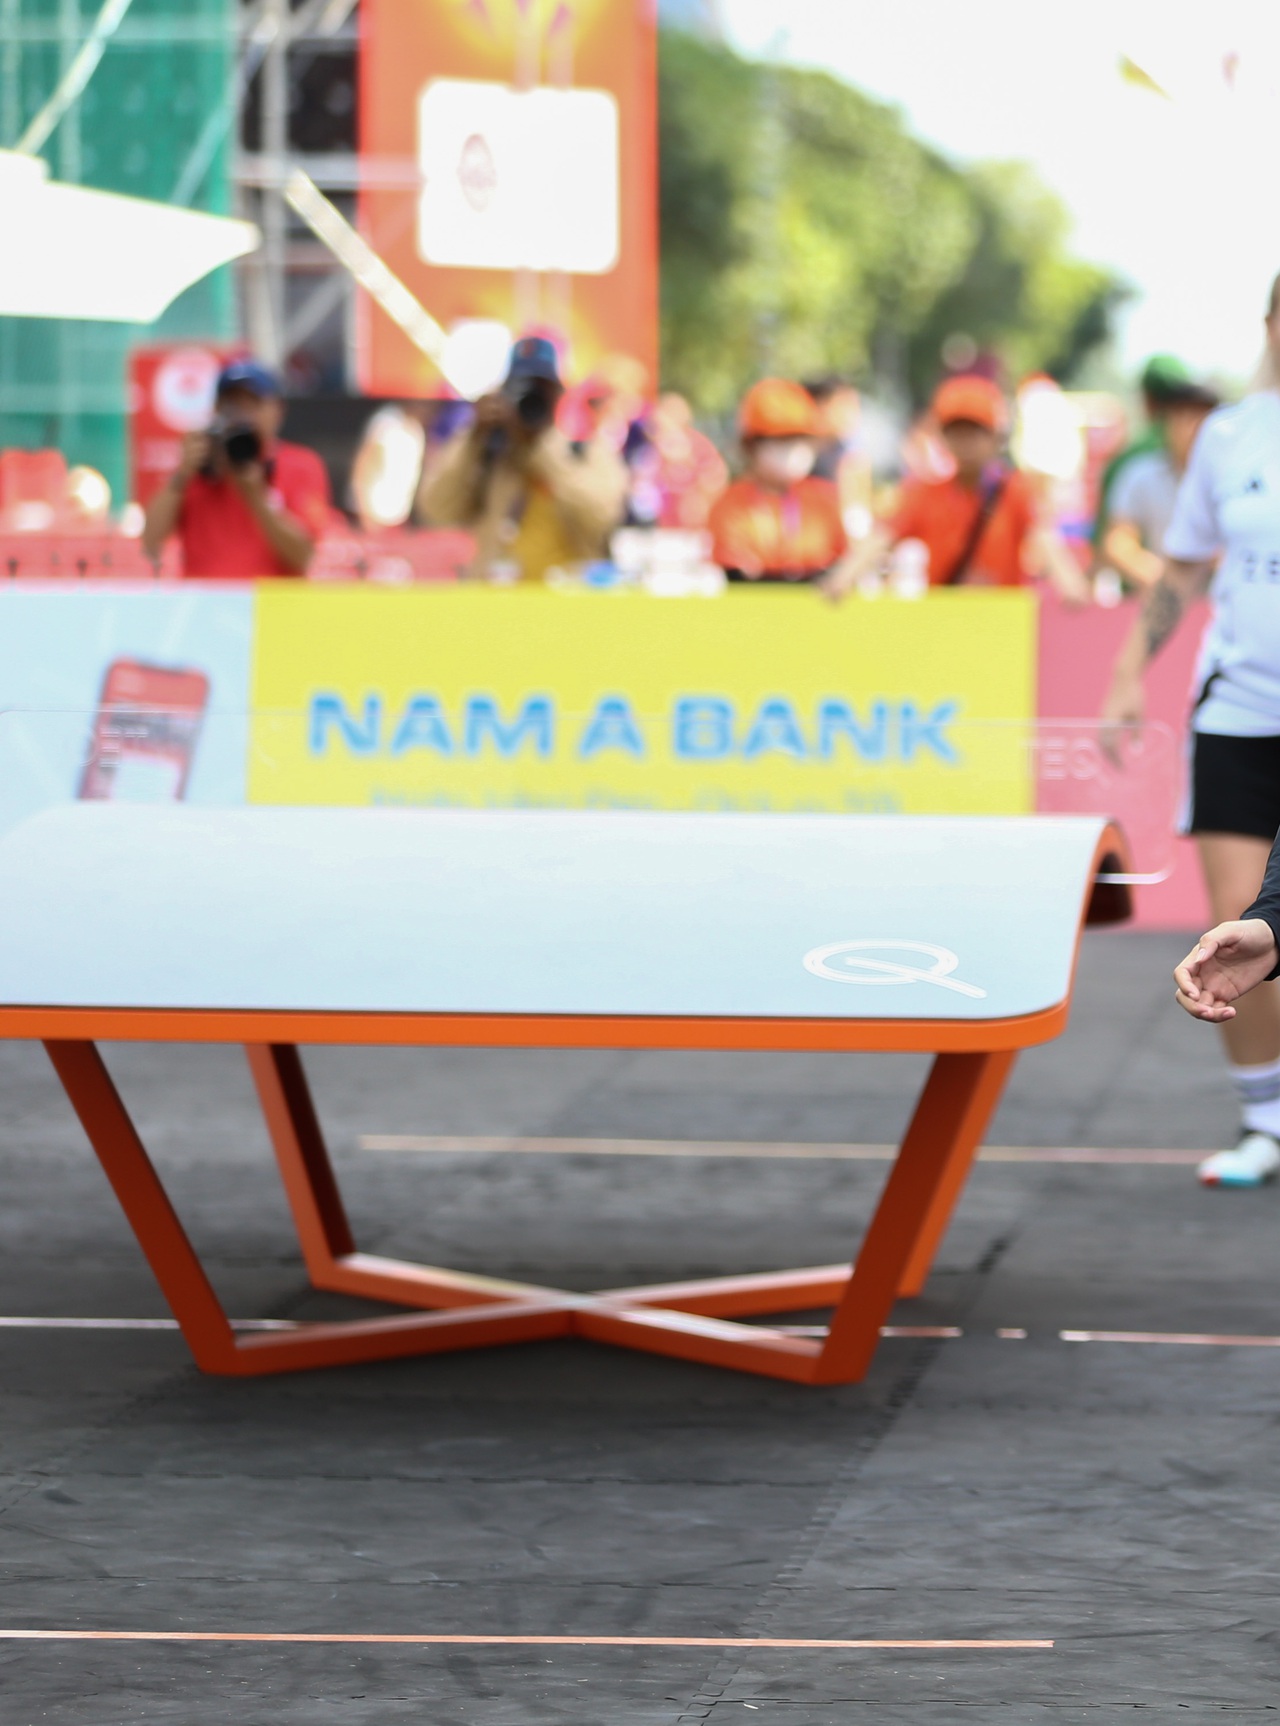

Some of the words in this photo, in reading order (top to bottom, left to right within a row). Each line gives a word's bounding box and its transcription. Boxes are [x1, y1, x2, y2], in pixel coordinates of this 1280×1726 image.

[308, 694, 551, 756] NAM
[578, 695, 647, 758] A
[672, 696, 963, 764] BANK
